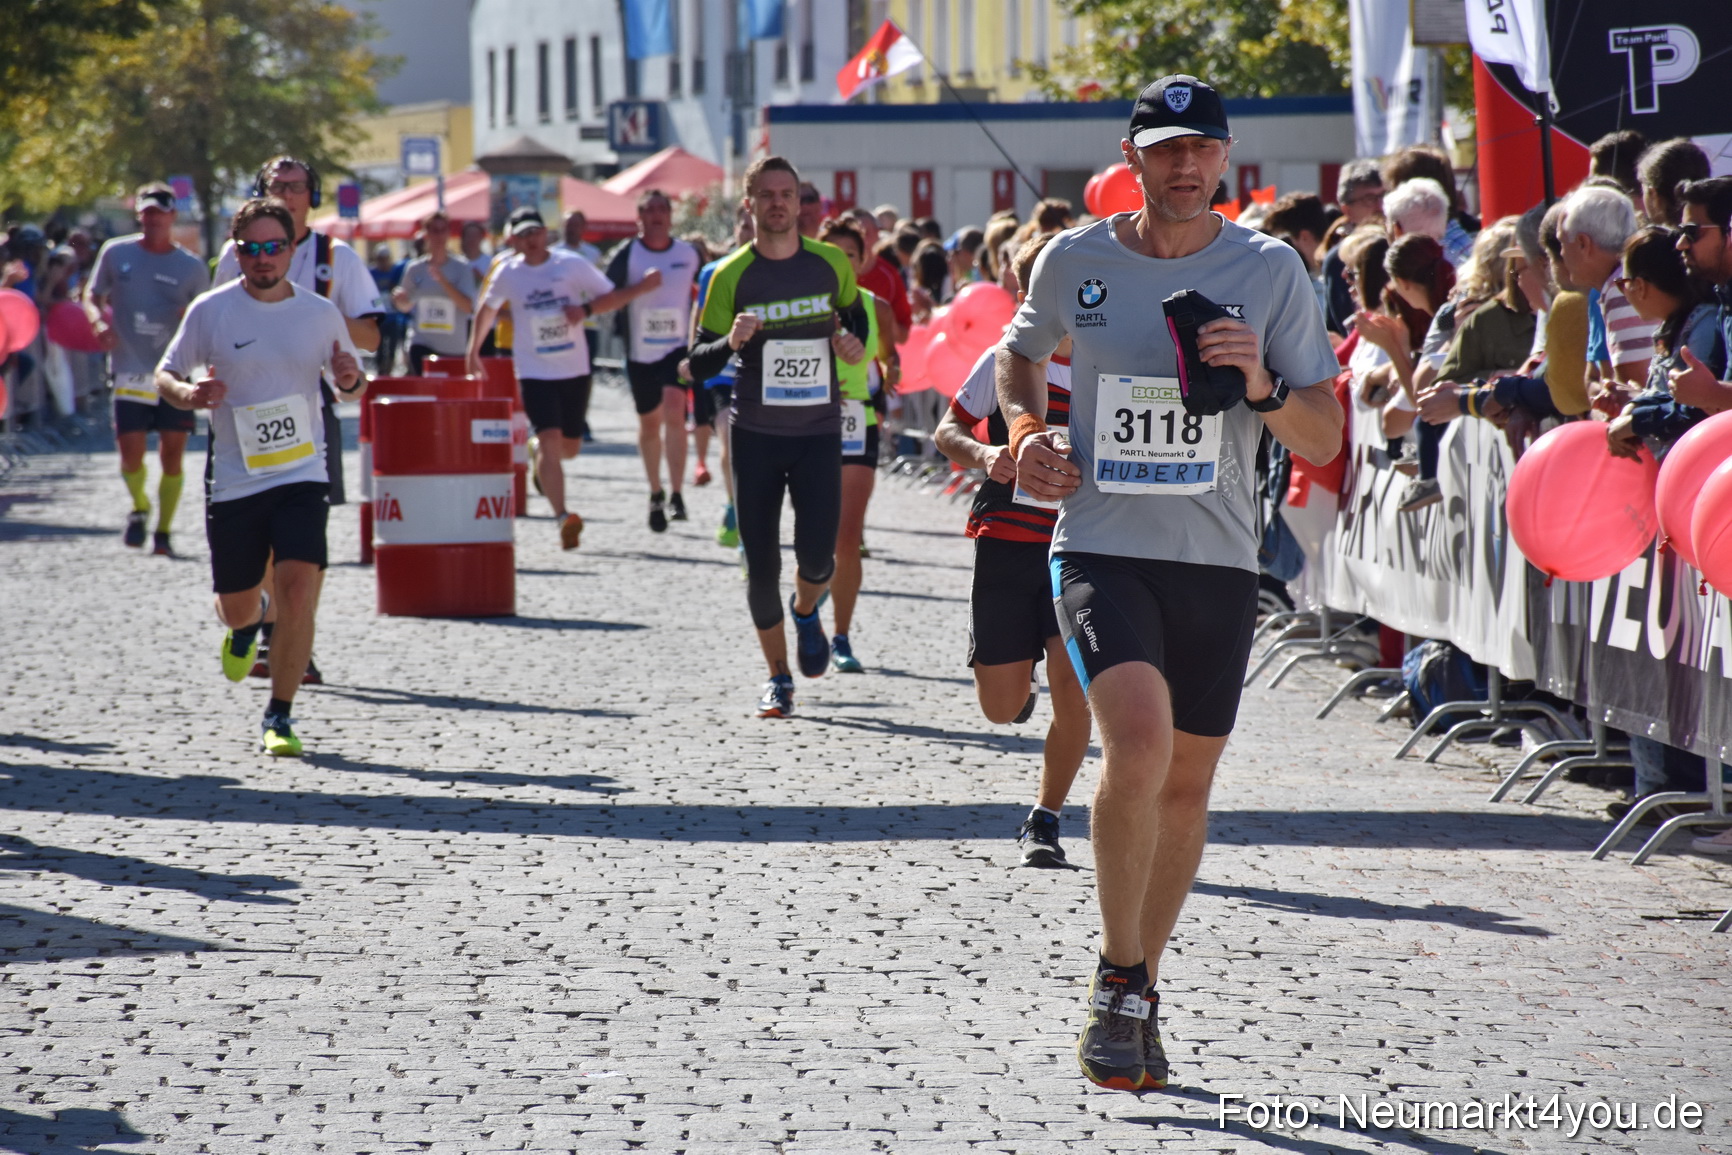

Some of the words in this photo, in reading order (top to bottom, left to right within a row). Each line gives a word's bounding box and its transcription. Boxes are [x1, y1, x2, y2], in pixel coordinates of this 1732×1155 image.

[1616, 34, 1643, 45] Team
[1075, 313, 1107, 322] PARTL
[1075, 321, 1107, 329] Neumarkt
[774, 357, 821, 378] 2527
[1131, 386, 1182, 400] BOCK
[256, 416, 297, 444] 329
[1113, 408, 1203, 445] 3118
[1120, 448, 1147, 457] PARTL
[1148, 449, 1184, 458] Neumarkt
[1100, 461, 1211, 482] HUBERT
